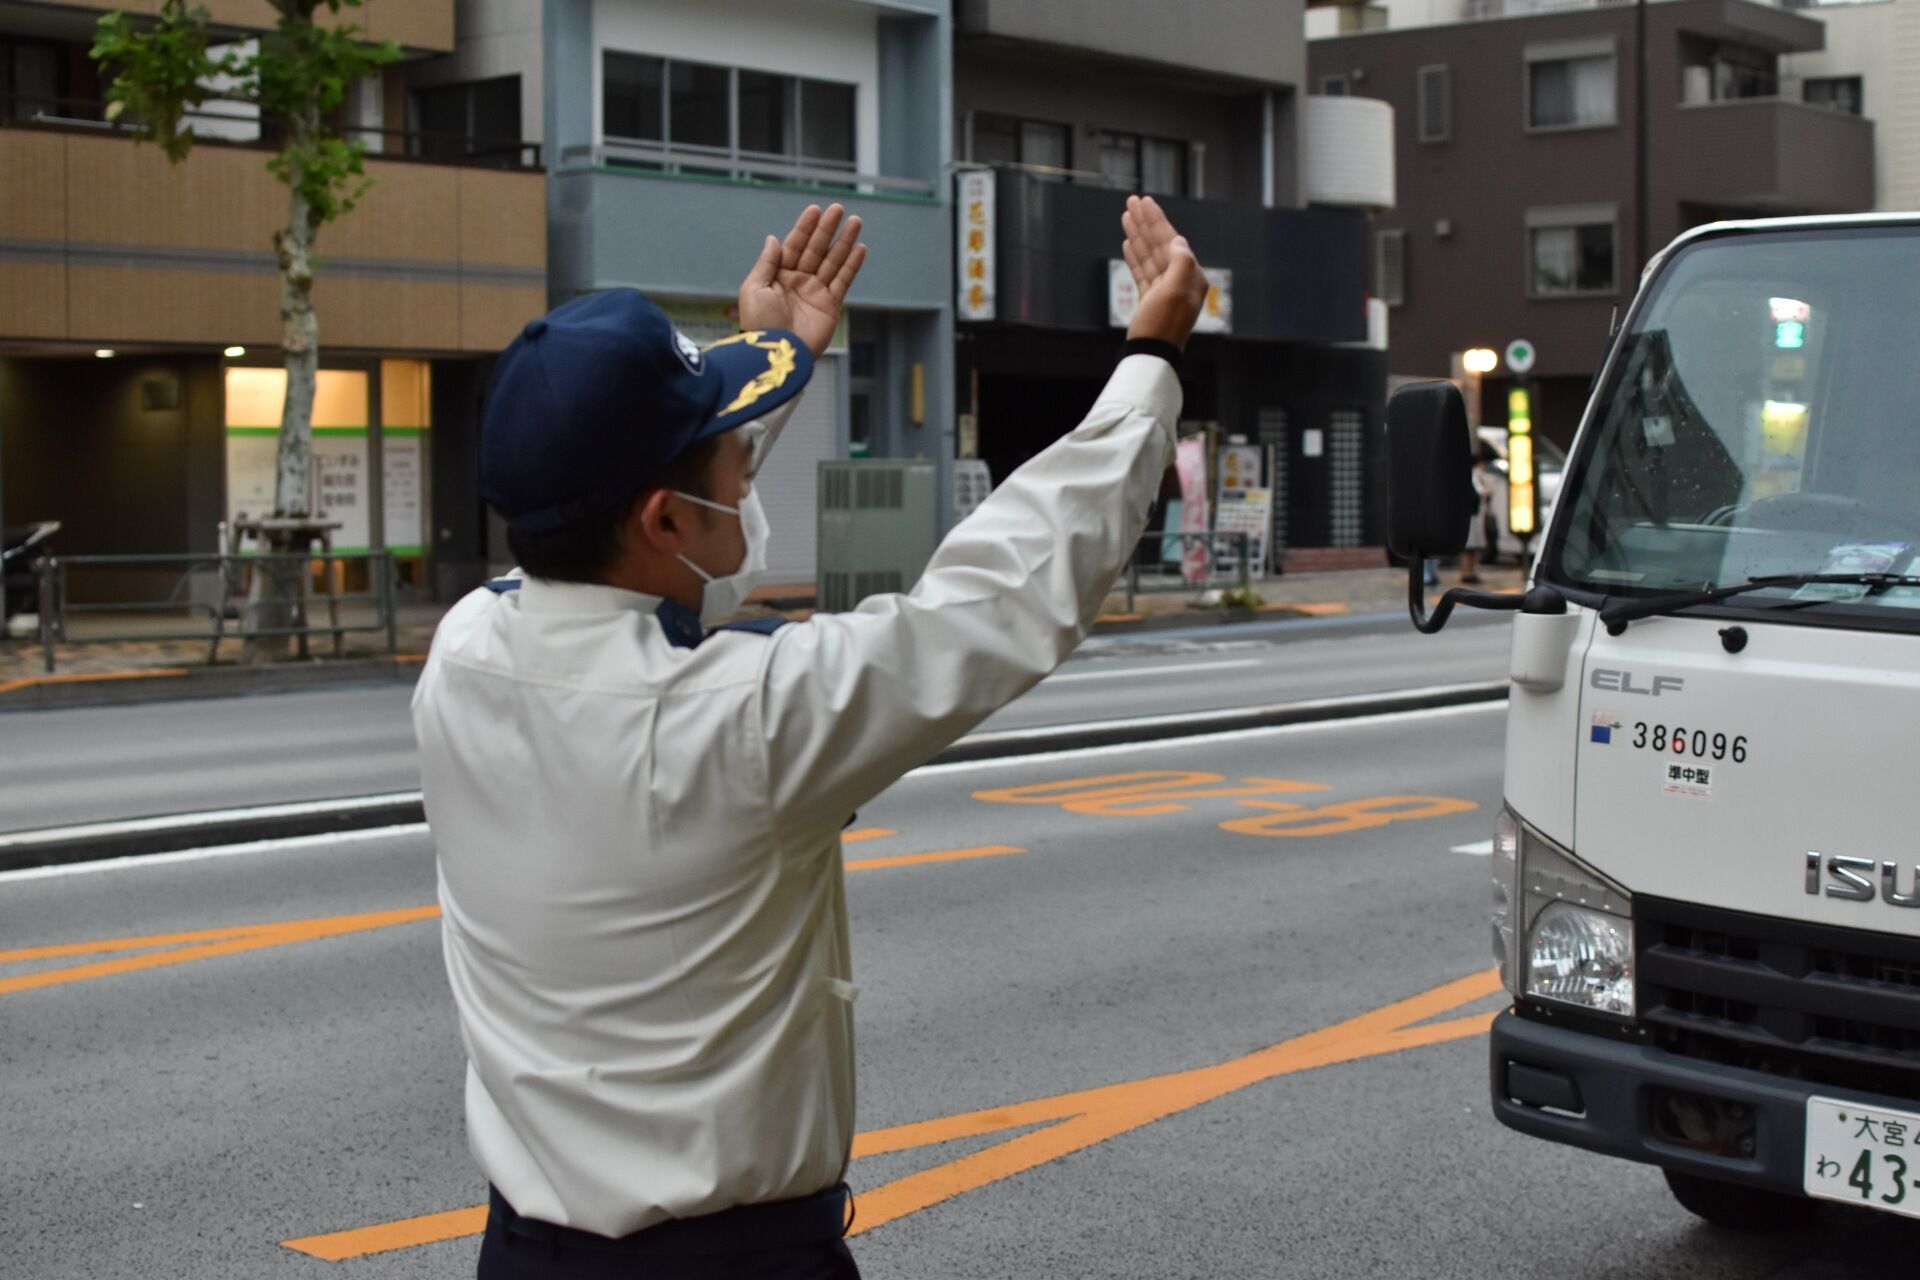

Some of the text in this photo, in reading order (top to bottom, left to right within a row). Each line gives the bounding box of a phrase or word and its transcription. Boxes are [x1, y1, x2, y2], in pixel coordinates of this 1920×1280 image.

[1590, 668, 1685, 697] ELF
[1632, 721, 1749, 763] 386096
[1668, 765, 1710, 785] 準中型
[1854, 1115, 1908, 1148] 大宮
[1816, 1153, 1842, 1179] わ
